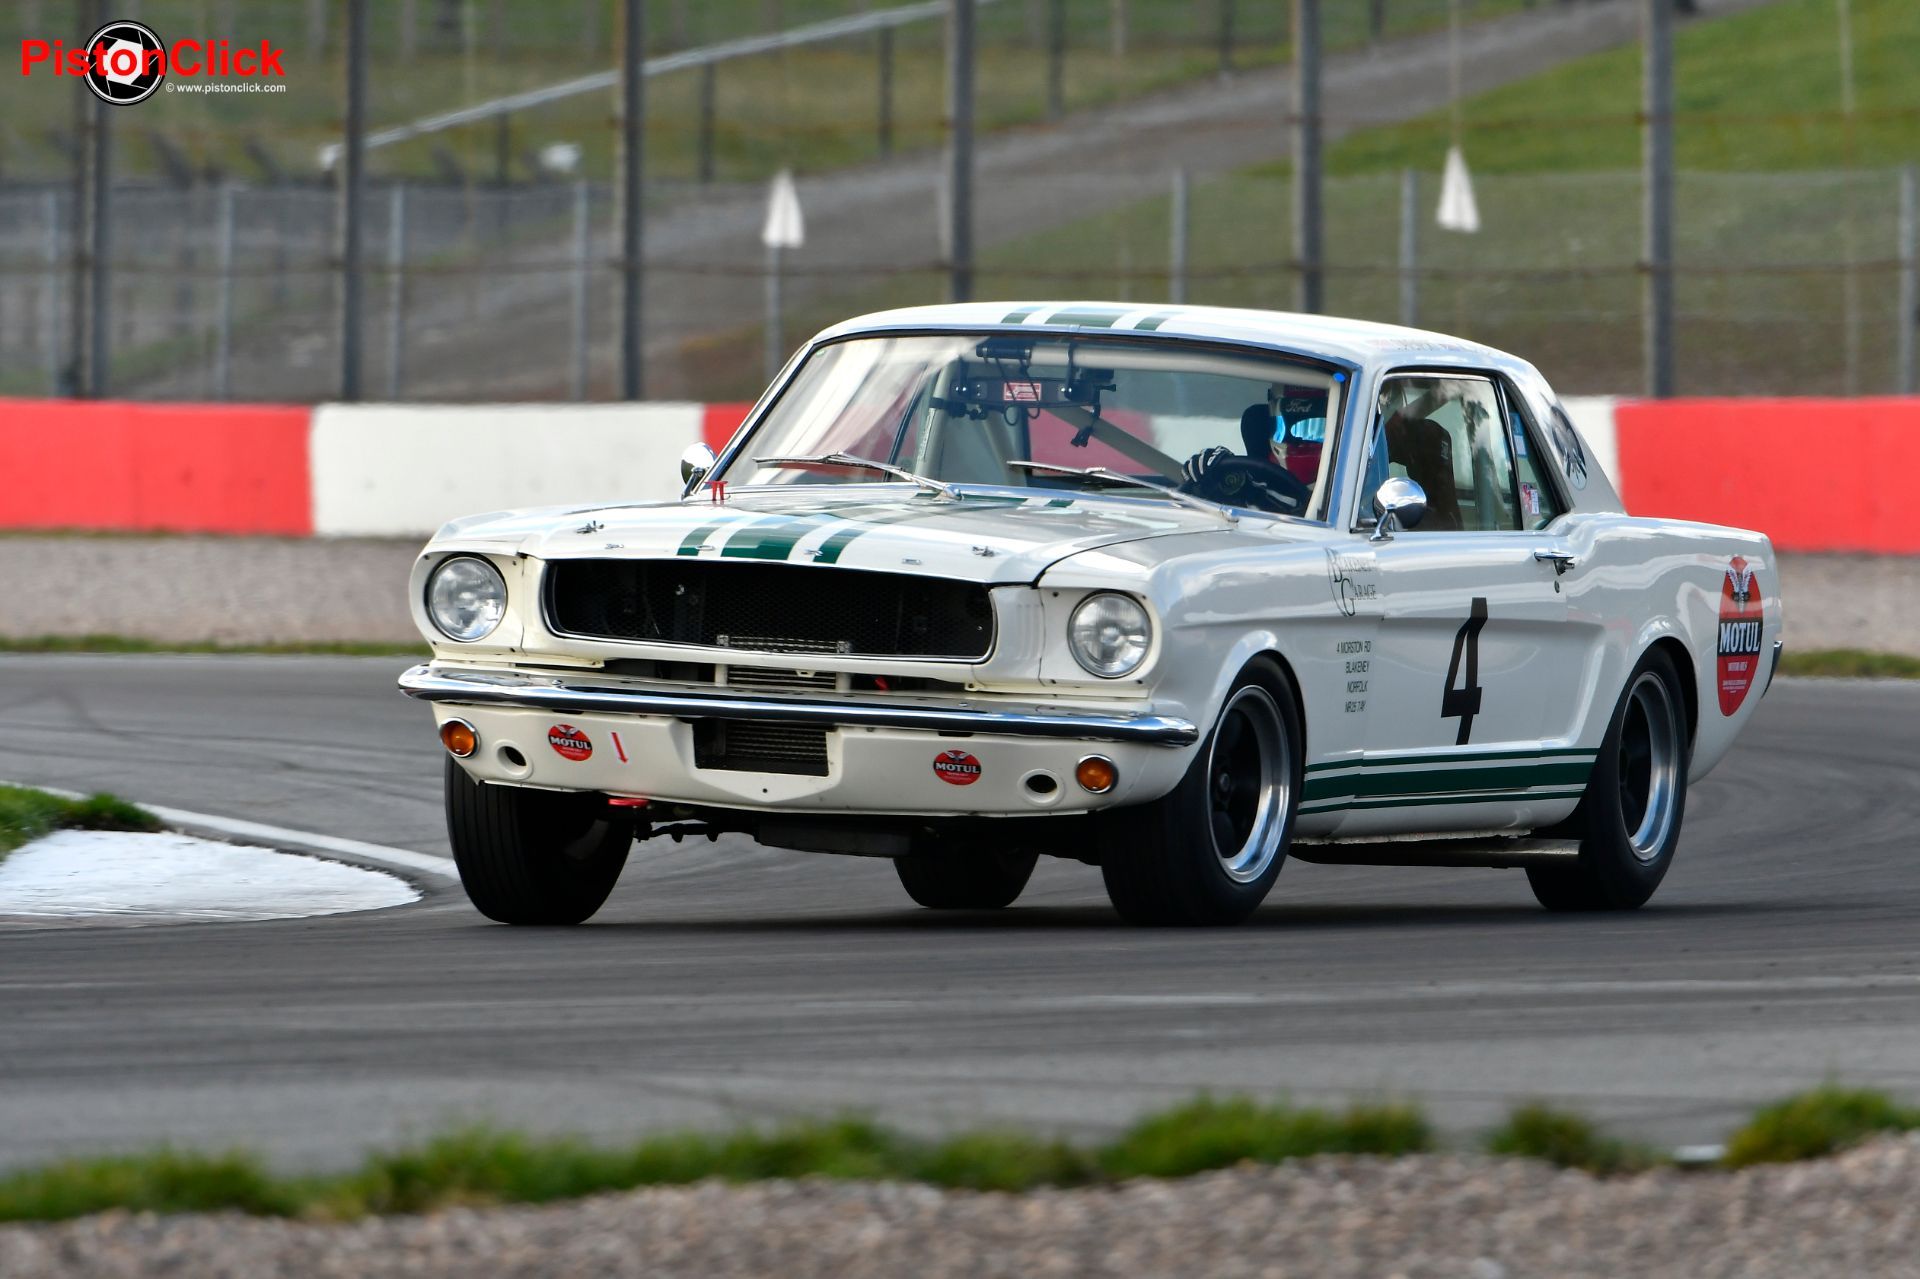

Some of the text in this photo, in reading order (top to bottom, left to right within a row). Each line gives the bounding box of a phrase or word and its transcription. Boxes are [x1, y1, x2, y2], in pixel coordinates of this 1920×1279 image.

[1286, 399, 1312, 413] Ford
[1719, 622, 1760, 653] MOTUL
[1441, 597, 1488, 746] 4
[1347, 680, 1368, 693] NORFOLK
[549, 736, 591, 750] MOTUL
[935, 762, 980, 773] MOTUL
